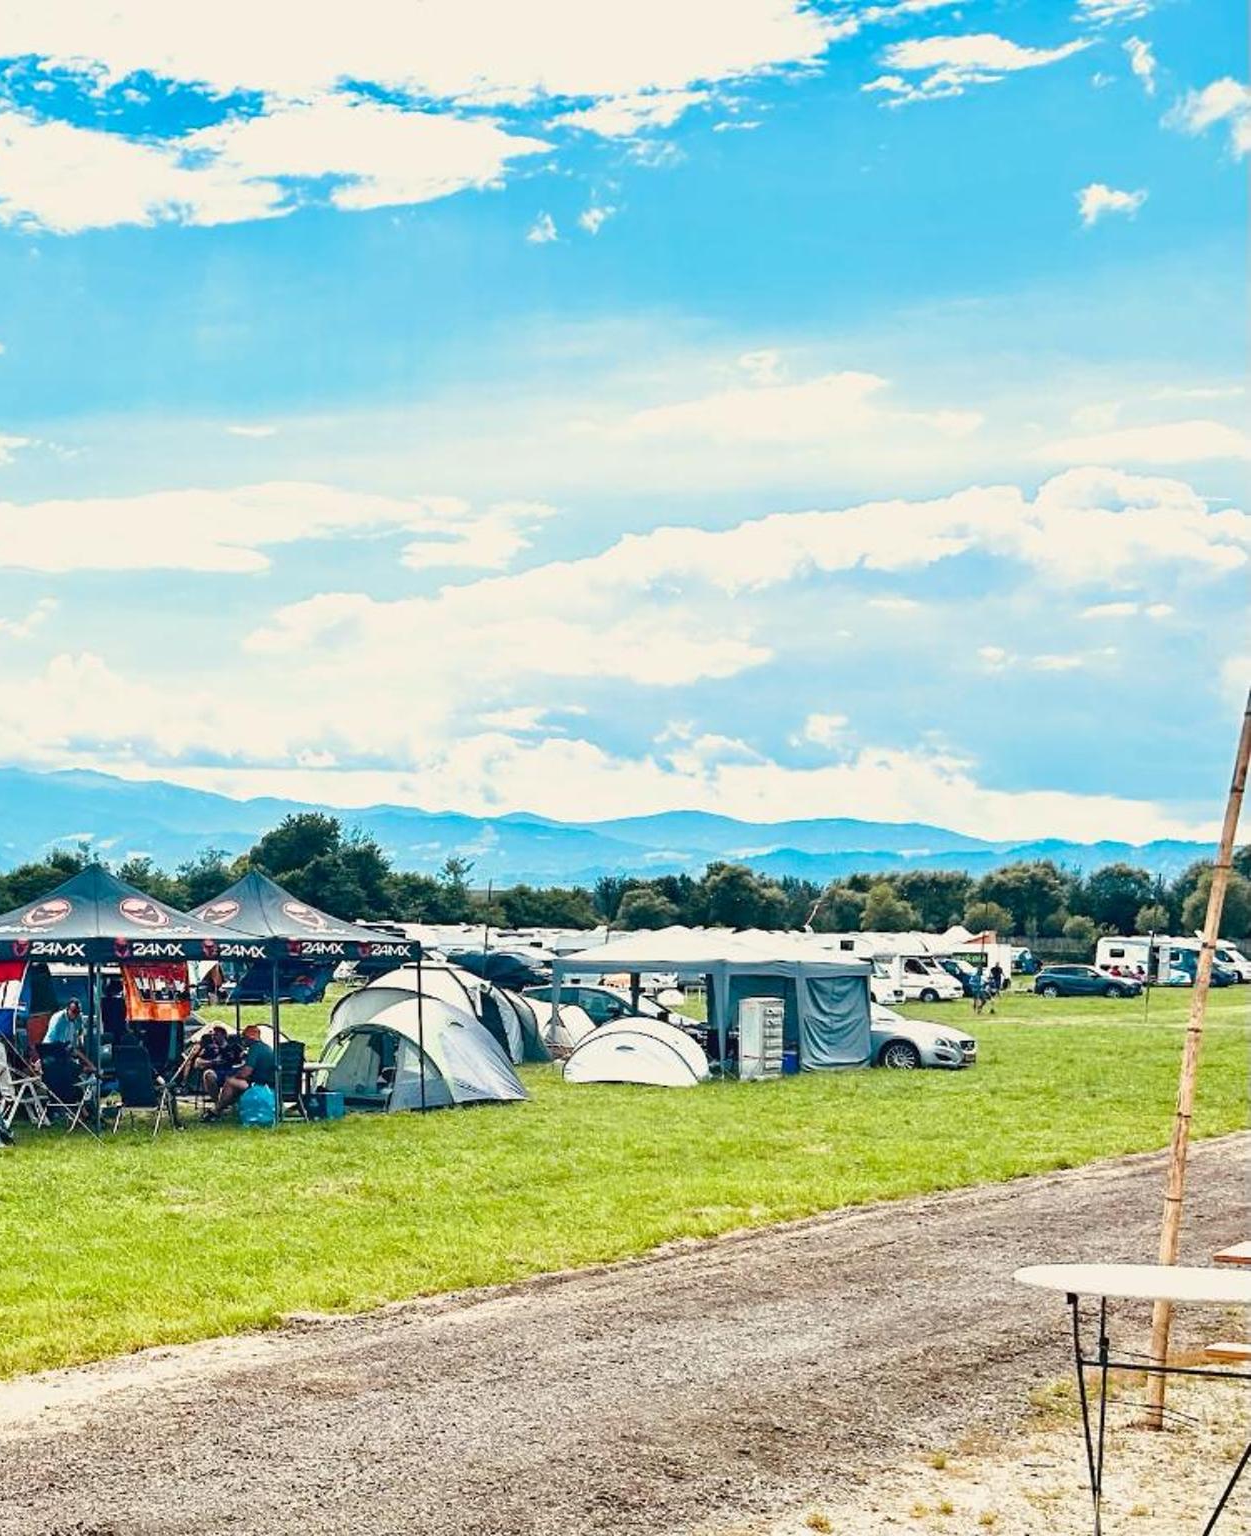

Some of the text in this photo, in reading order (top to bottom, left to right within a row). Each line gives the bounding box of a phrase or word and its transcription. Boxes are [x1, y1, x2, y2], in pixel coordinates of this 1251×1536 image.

[30, 941, 86, 958] 24MX
[132, 942, 186, 957] 24MX
[219, 943, 266, 959] 24MX
[301, 941, 345, 955] 24MX
[370, 943, 412, 957] 24MX
